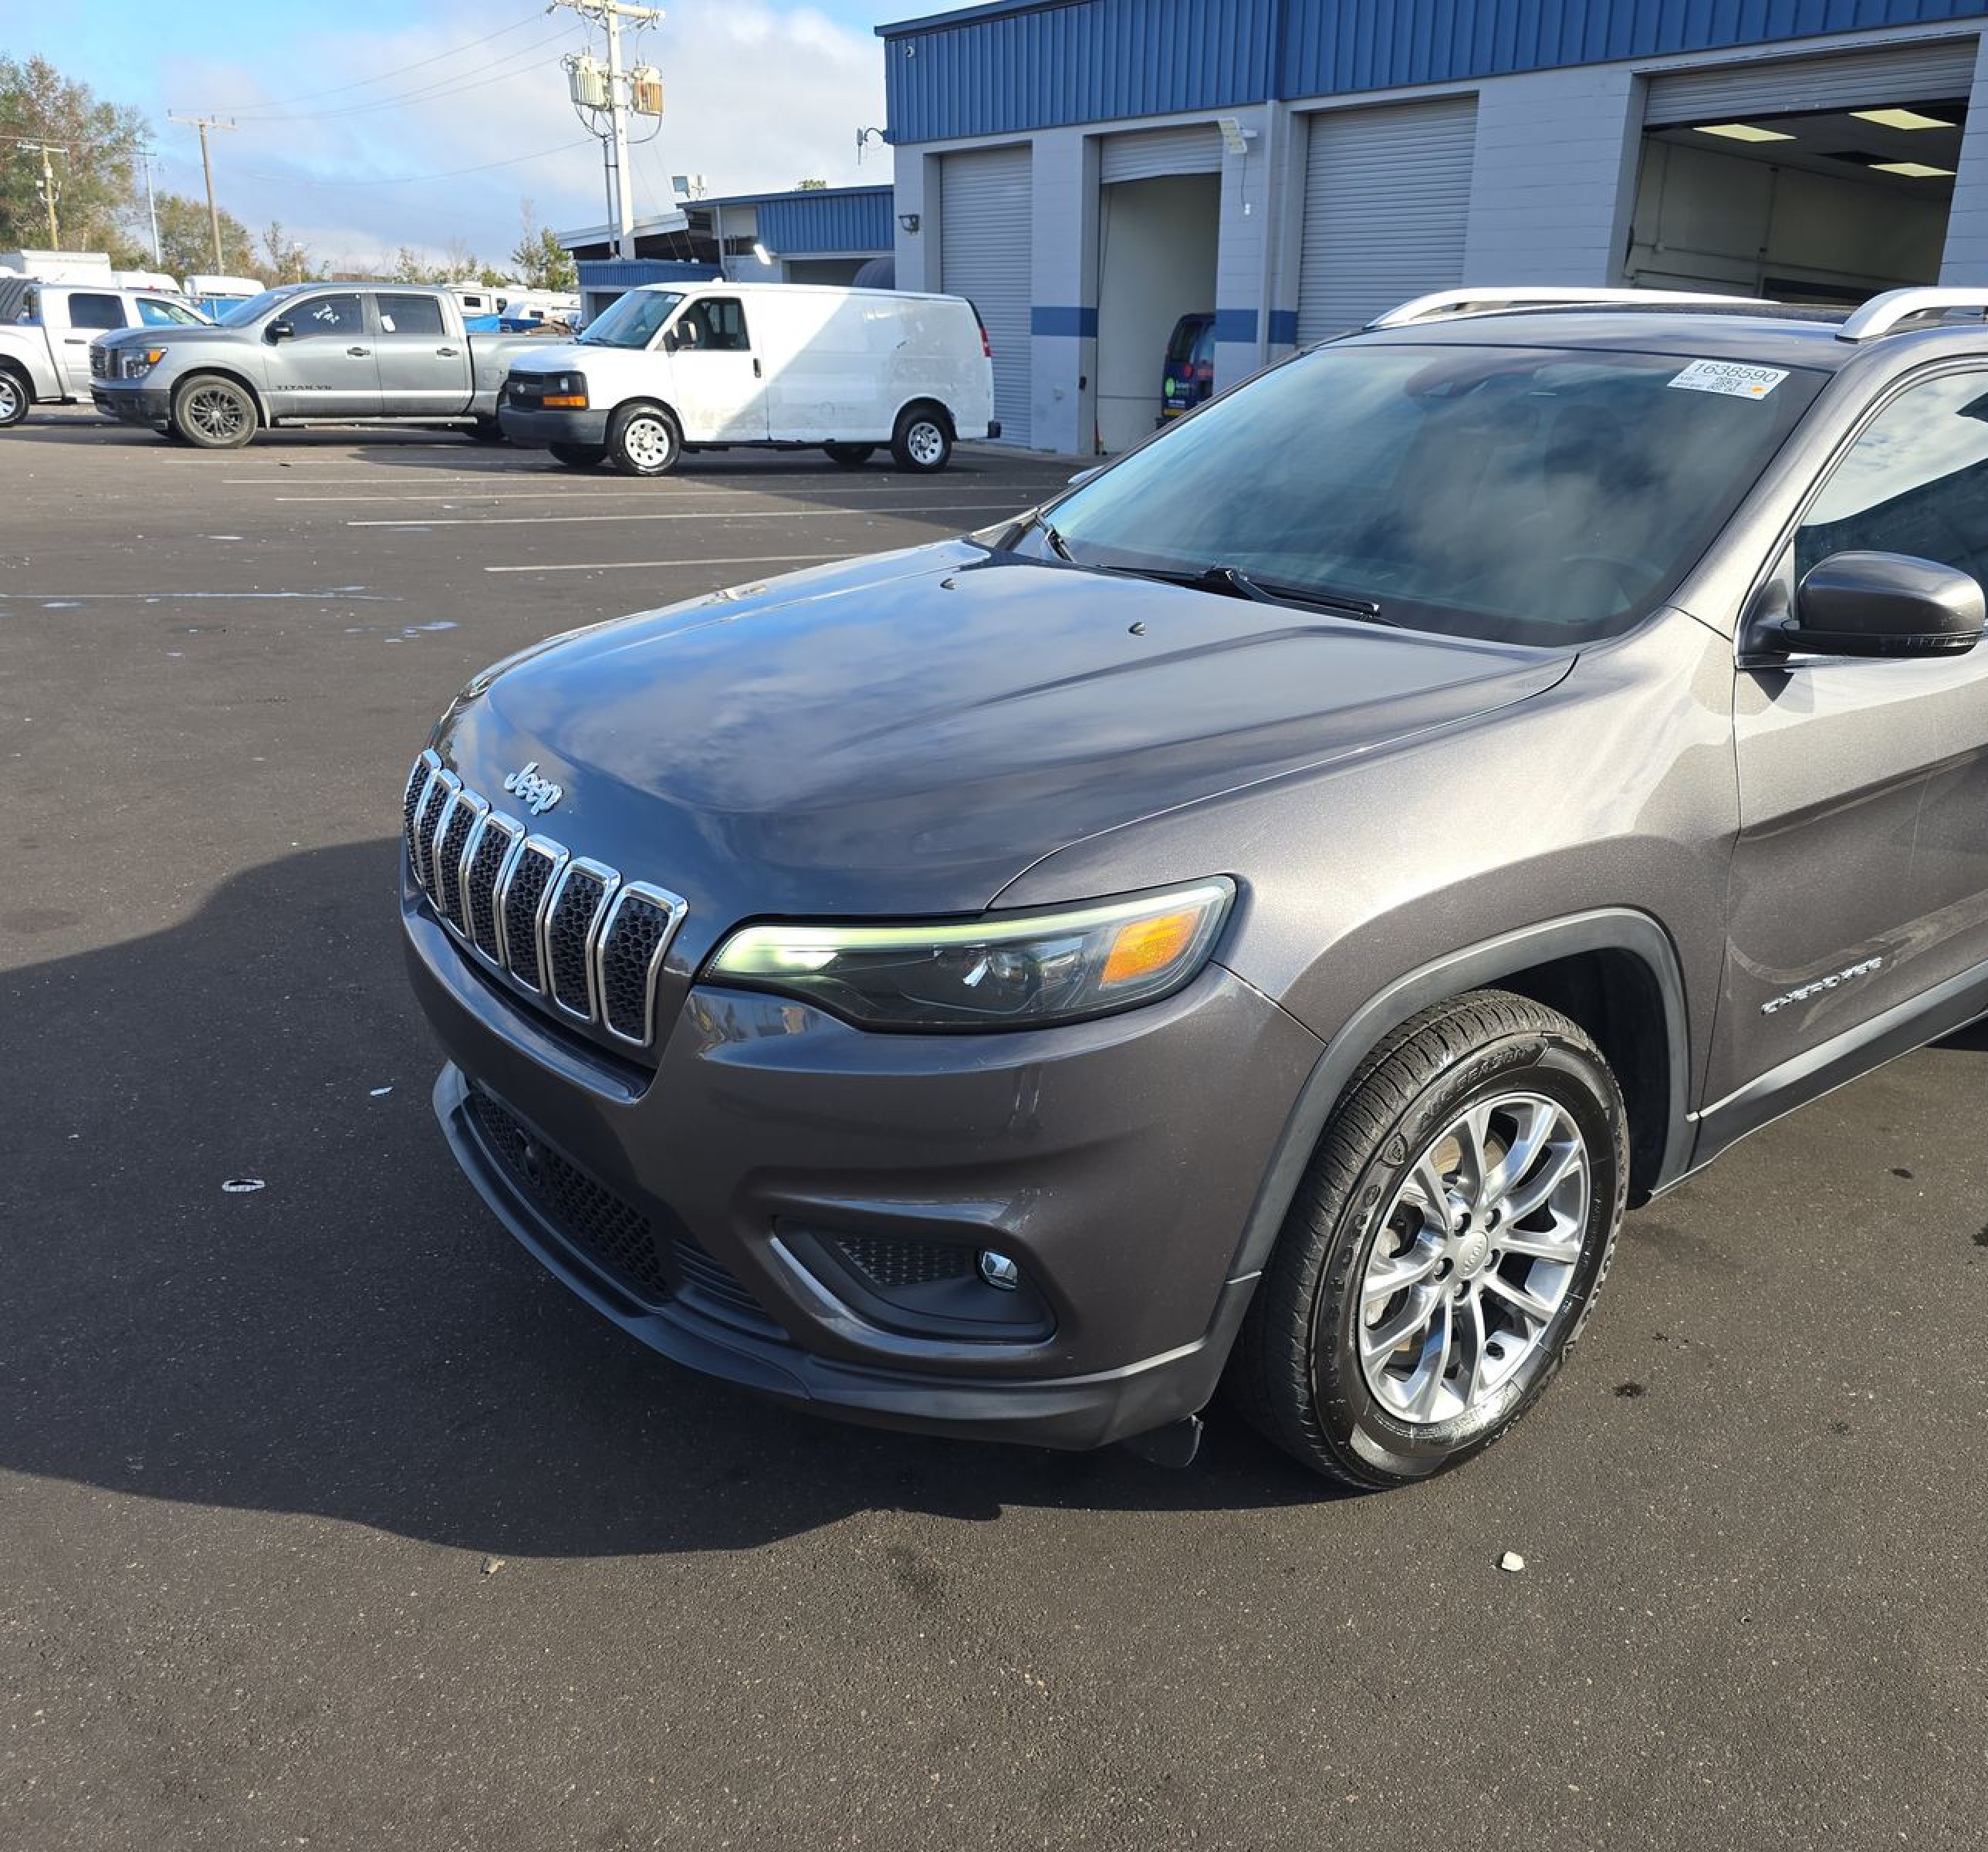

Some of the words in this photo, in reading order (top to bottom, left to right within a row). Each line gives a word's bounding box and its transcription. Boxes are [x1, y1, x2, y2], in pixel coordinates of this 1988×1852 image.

[1694, 362, 1779, 383] 1638590
[504, 762, 564, 816] Jeep
[1760, 956, 1882, 1014] CHEROKEE
